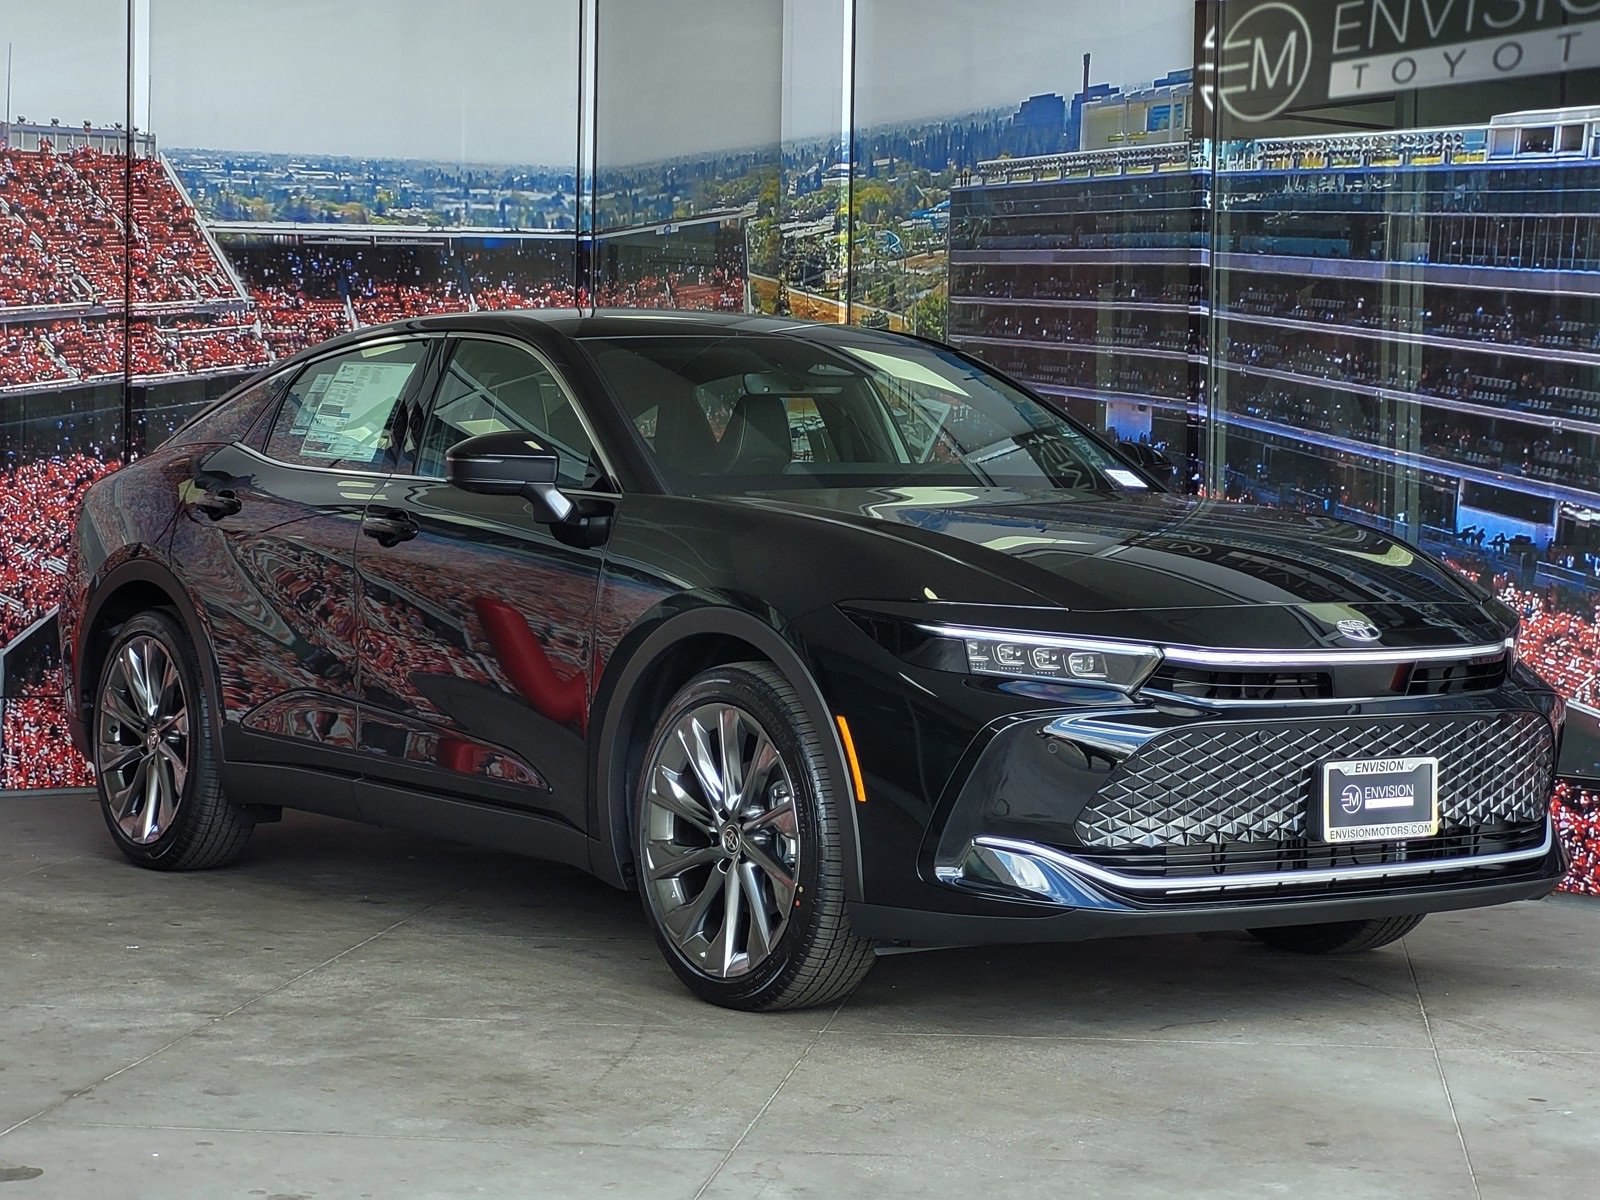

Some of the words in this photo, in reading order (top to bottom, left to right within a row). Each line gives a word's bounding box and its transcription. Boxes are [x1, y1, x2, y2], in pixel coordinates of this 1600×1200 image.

[1332, 0, 1600, 54] ENVIS
[1352, 31, 1583, 89] TOYOT
[1355, 760, 1405, 773] ENVISION
[1364, 784, 1414, 799] ENVISION
[1330, 824, 1432, 840] ENVISIONMOTORS.COM
